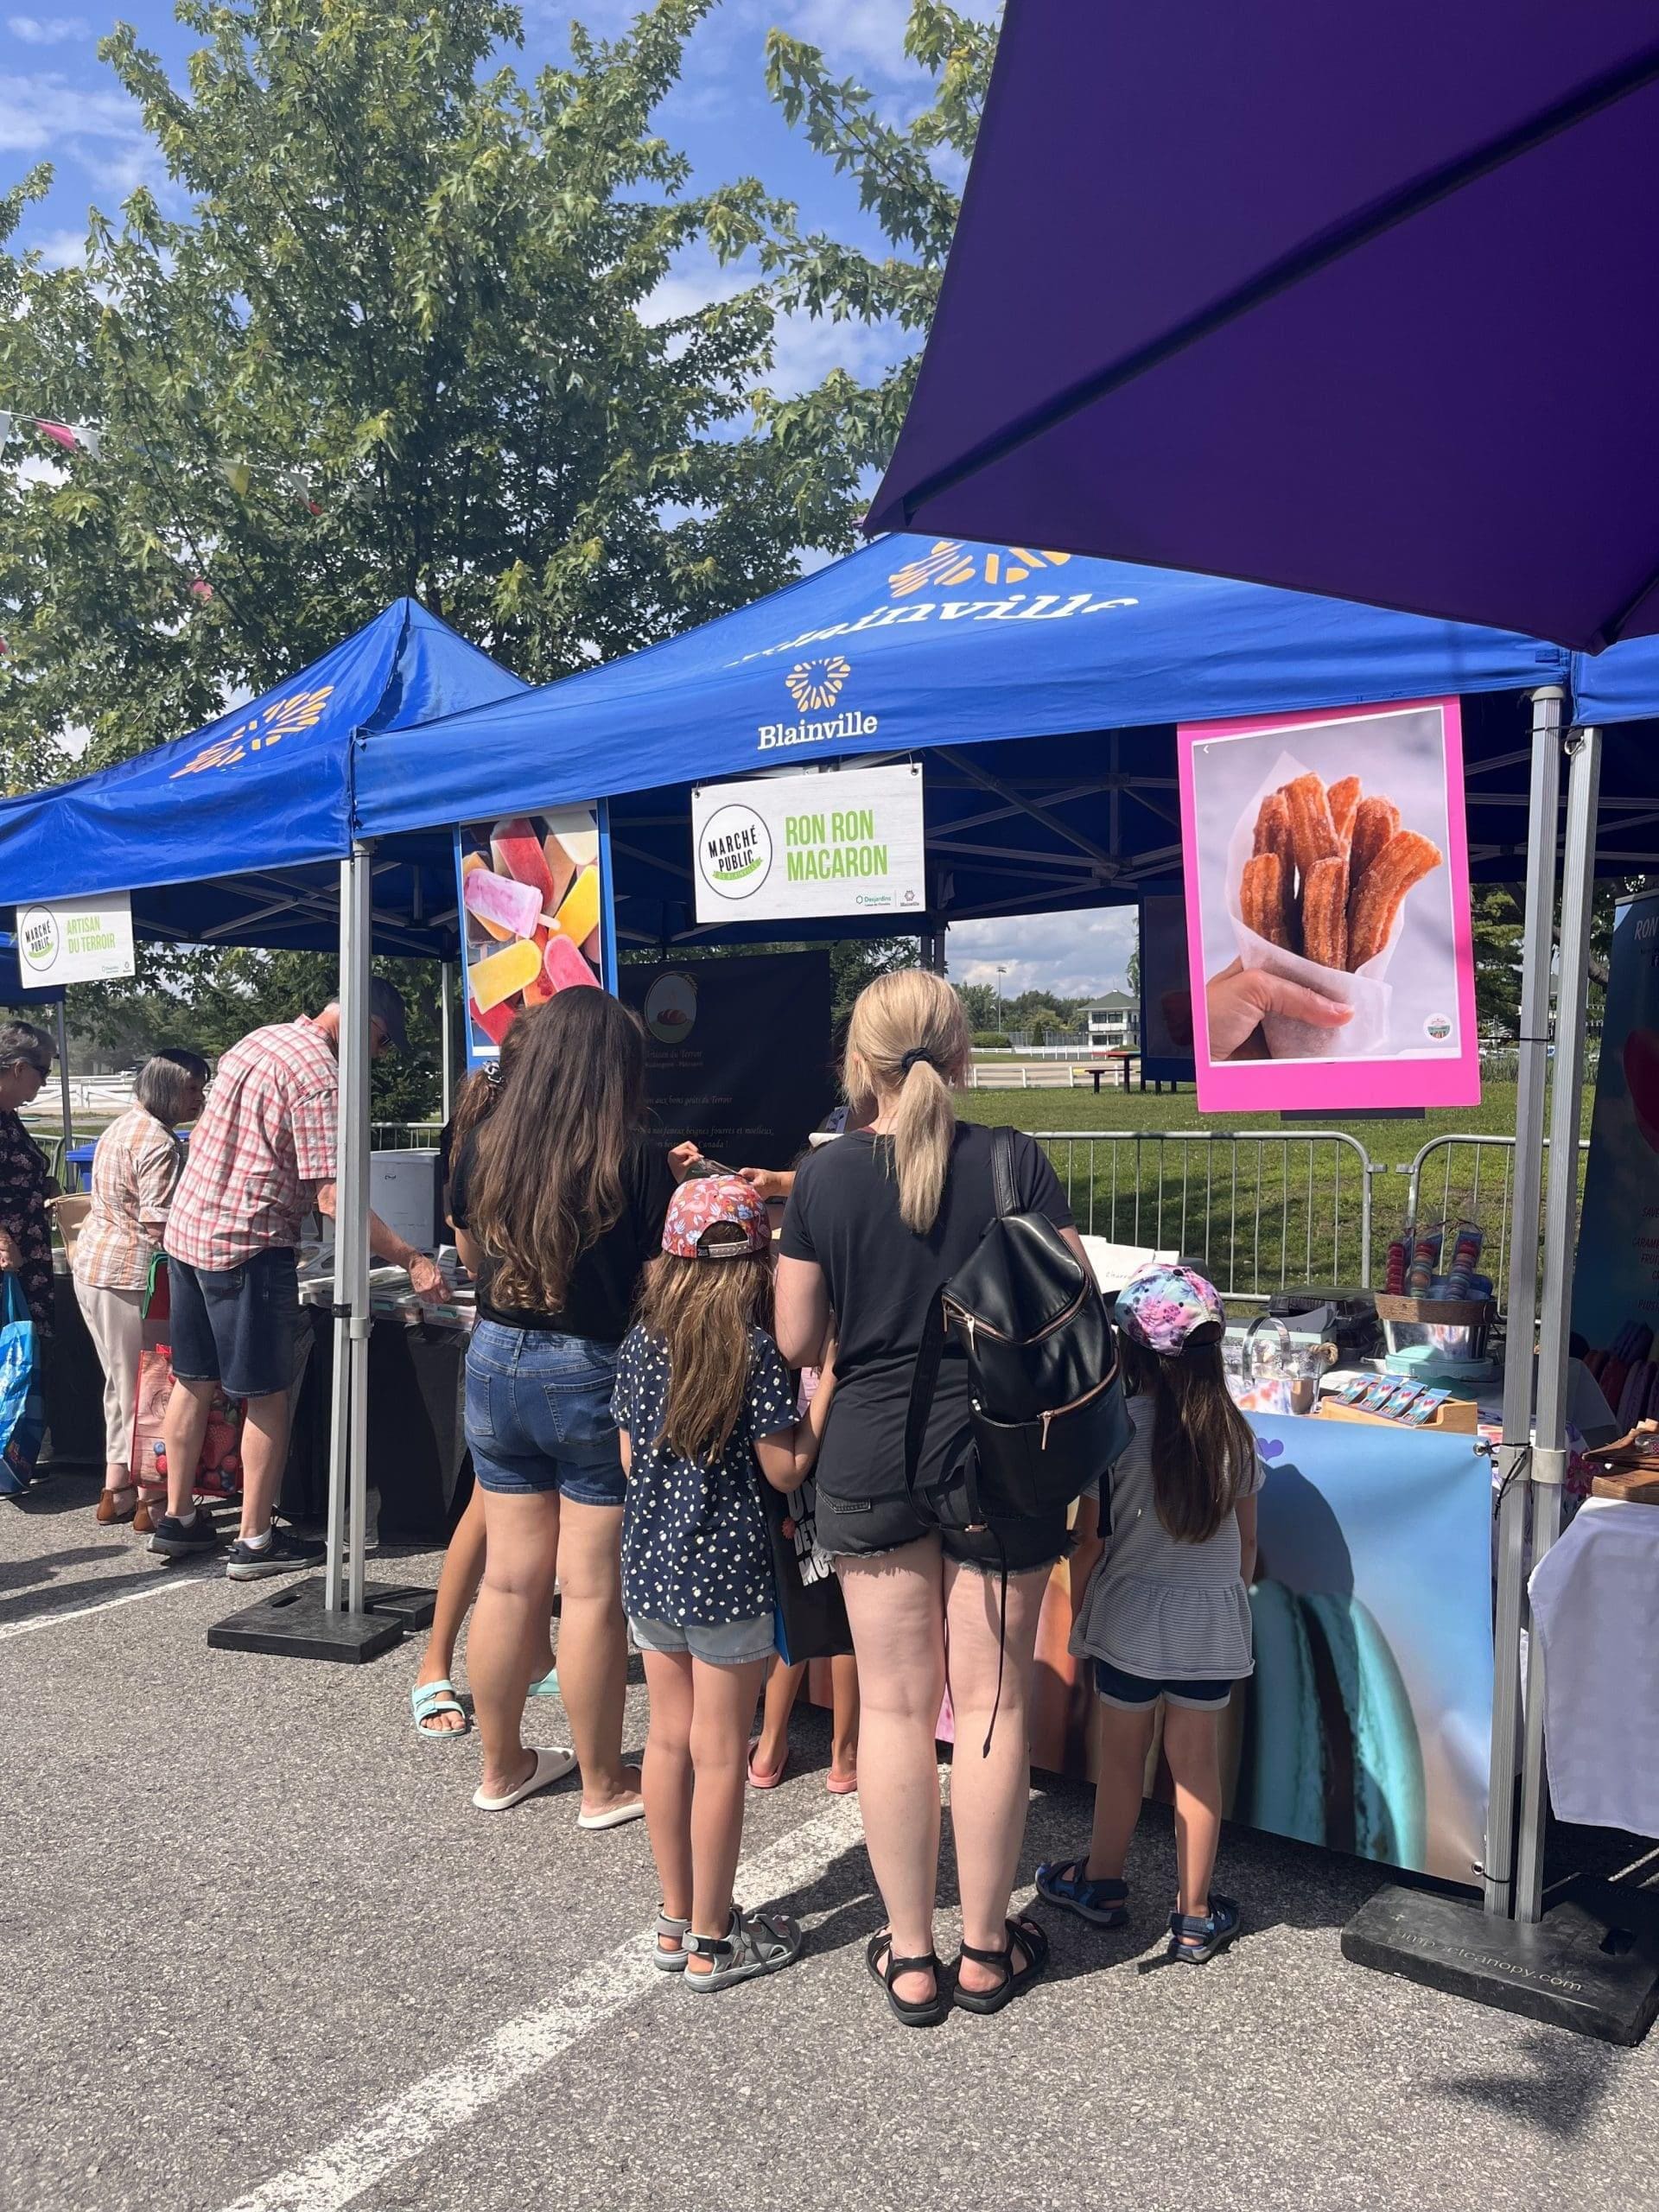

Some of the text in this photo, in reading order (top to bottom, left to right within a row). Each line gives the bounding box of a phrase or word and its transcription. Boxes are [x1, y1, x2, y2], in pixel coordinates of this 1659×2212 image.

[757, 711, 879, 751] Blainville
[785, 809, 874, 847] RON RON
[709, 824, 758, 859] MARCHÉ
[718, 849, 754, 873] PUBLIC
[787, 844, 888, 881] MACARON
[67, 915, 101, 936] ARTISAN
[1634, 916, 1659, 940] RON
[30, 936, 50, 953] PUBLIC
[68, 932, 117, 954] DU TERROIR
